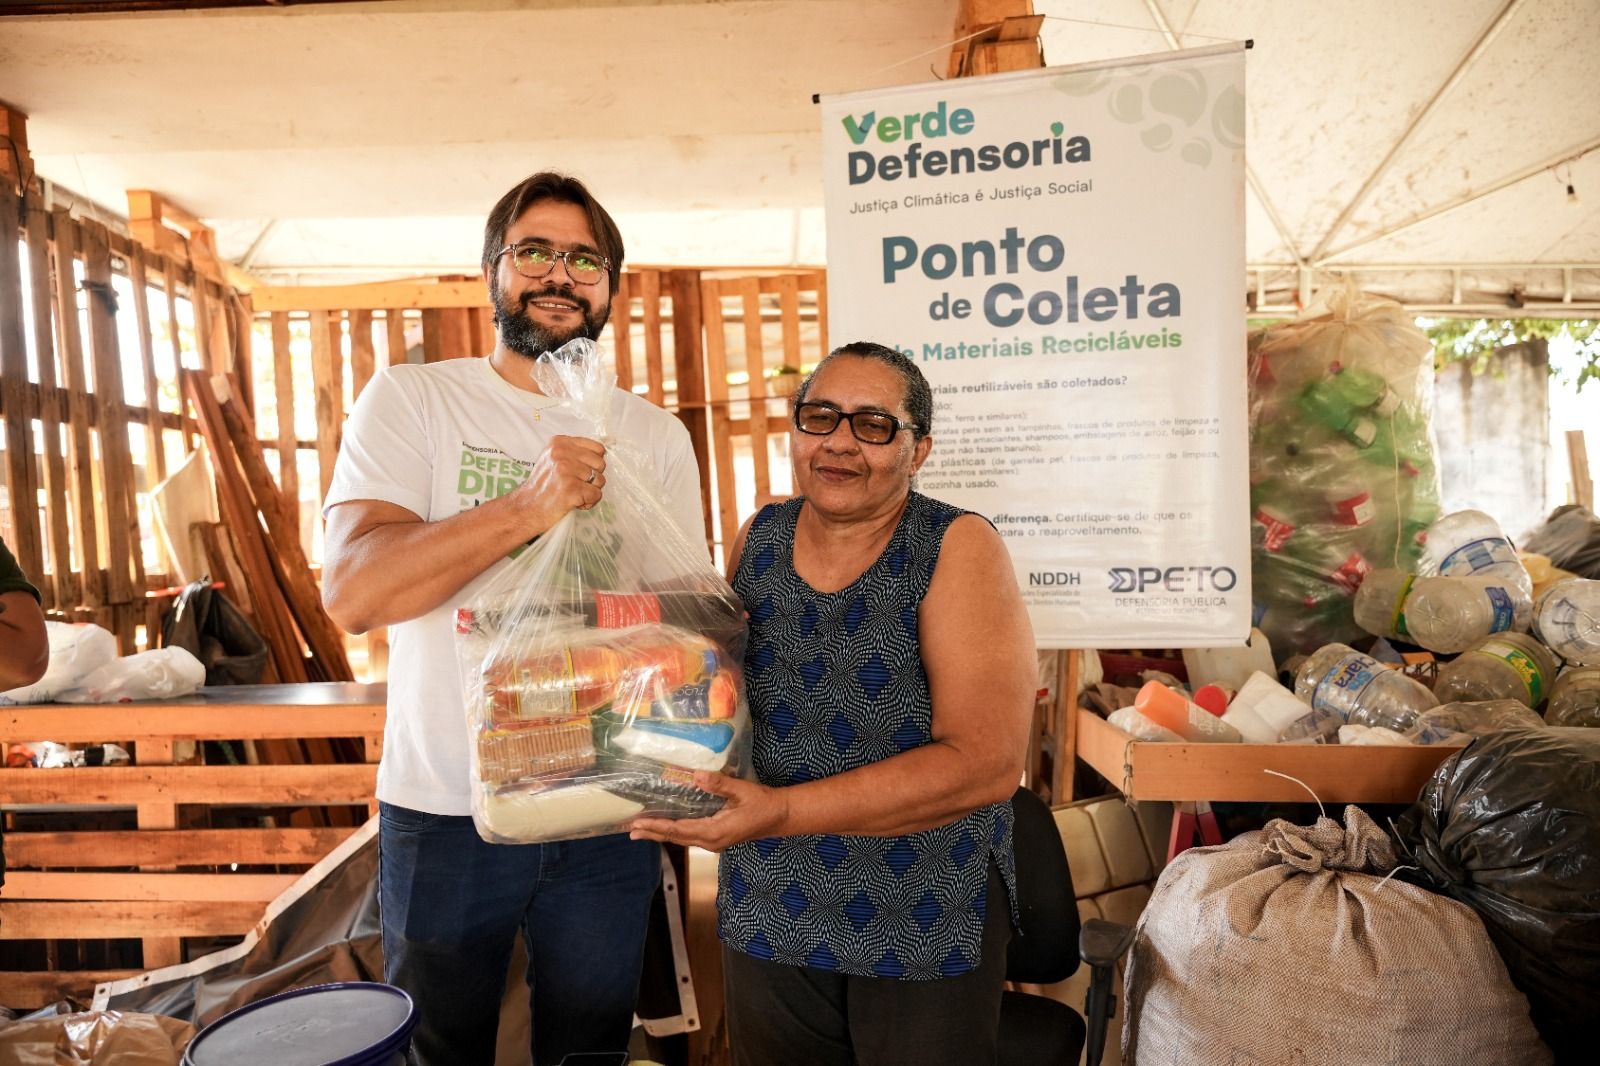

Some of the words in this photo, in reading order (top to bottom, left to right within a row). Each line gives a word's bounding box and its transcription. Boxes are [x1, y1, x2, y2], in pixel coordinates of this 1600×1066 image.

[841, 100, 975, 145] Verde
[848, 122, 1091, 185] Defensoria
[849, 198, 898, 214] Justiça
[903, 189, 969, 209] Climática
[975, 189, 984, 202] é
[989, 184, 1042, 201] Justiça
[1048, 179, 1093, 195] Social
[882, 226, 1065, 284] Ponto
[929, 292, 971, 321] de
[983, 274, 1181, 328] Coleta
[922, 337, 1033, 362] Materiais
[1041, 327, 1182, 355] Recicláveis
[931, 384, 958, 394] riais
[961, 379, 1033, 393] reutilizáveis
[1037, 378, 1058, 390] são
[1062, 375, 1128, 389] coletados?
[1174, 416, 1209, 427] limpeza
[941, 456, 986, 468] plásticas
[923, 479, 962, 490] cozinha
[965, 478, 999, 489] usado.
[992, 512, 1053, 526] diferença.
[1055, 511, 1130, 525] Certifique-se
[1153, 511, 1177, 523] que
[1000, 528, 1024, 538] para
[1027, 529, 1036, 537] o
[1039, 525, 1142, 538] reaproveitamento.
[1029, 572, 1081, 586] NDDH
